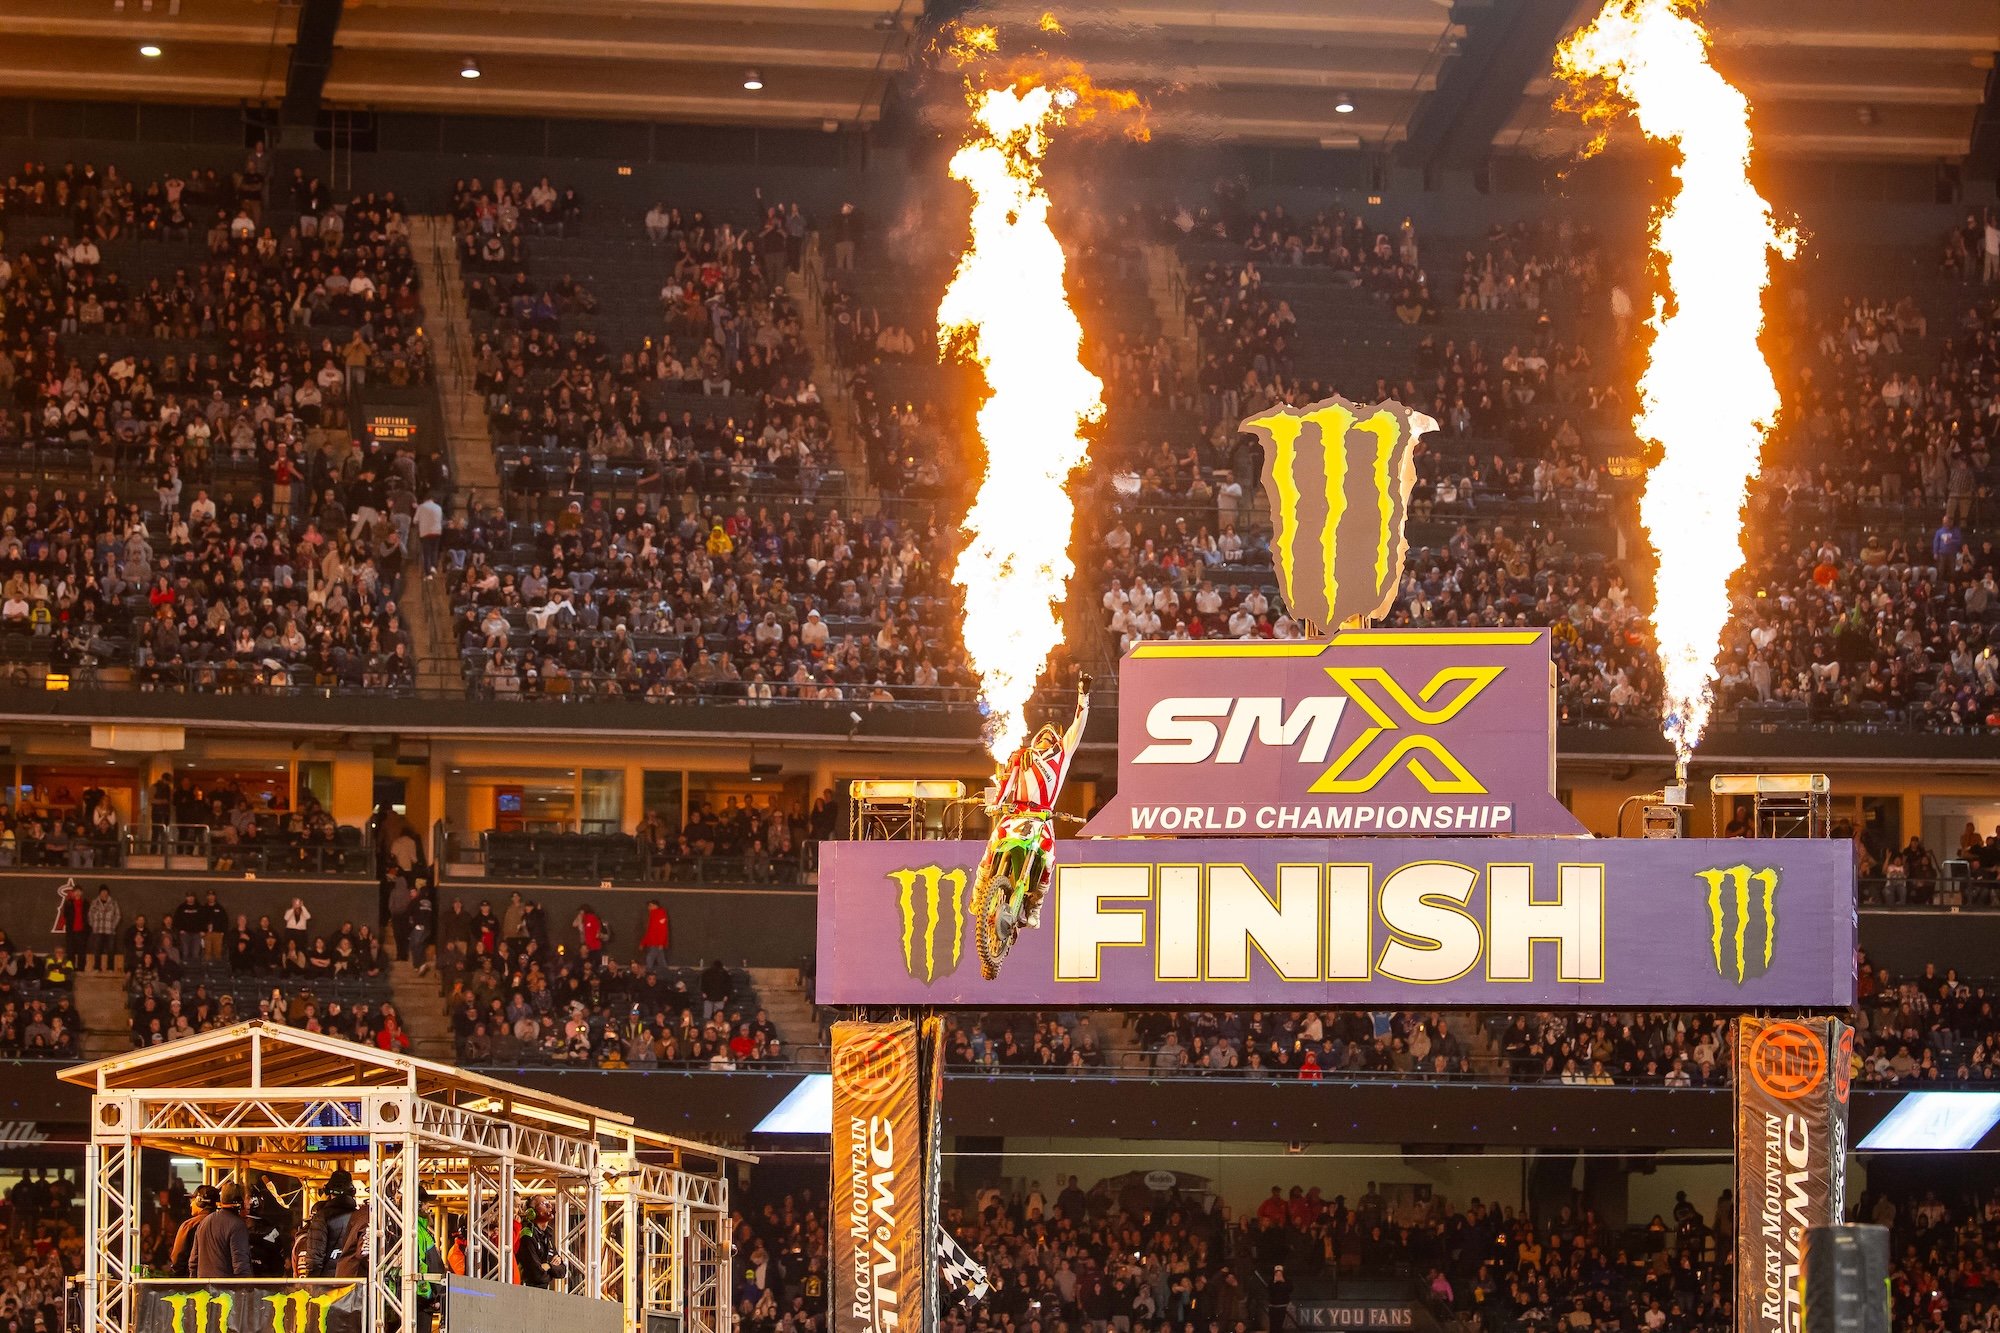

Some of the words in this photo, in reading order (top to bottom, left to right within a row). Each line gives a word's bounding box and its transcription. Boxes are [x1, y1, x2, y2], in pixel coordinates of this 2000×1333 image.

[1131, 667, 1506, 795] SMX
[1131, 806, 1247, 830] WORLD
[1256, 806, 1512, 830] CHAMPIONSHIP
[1054, 860, 1605, 984] FINISH
[850, 1115, 870, 1243] MOUNTAIN
[1762, 1112, 1782, 1243] MOUNTAIN
[853, 1244, 872, 1323] ROCKY
[1329, 1307, 1364, 1327] YOU
[1369, 1307, 1412, 1327] FANS
[1762, 1243, 1781, 1324] ROCKY
